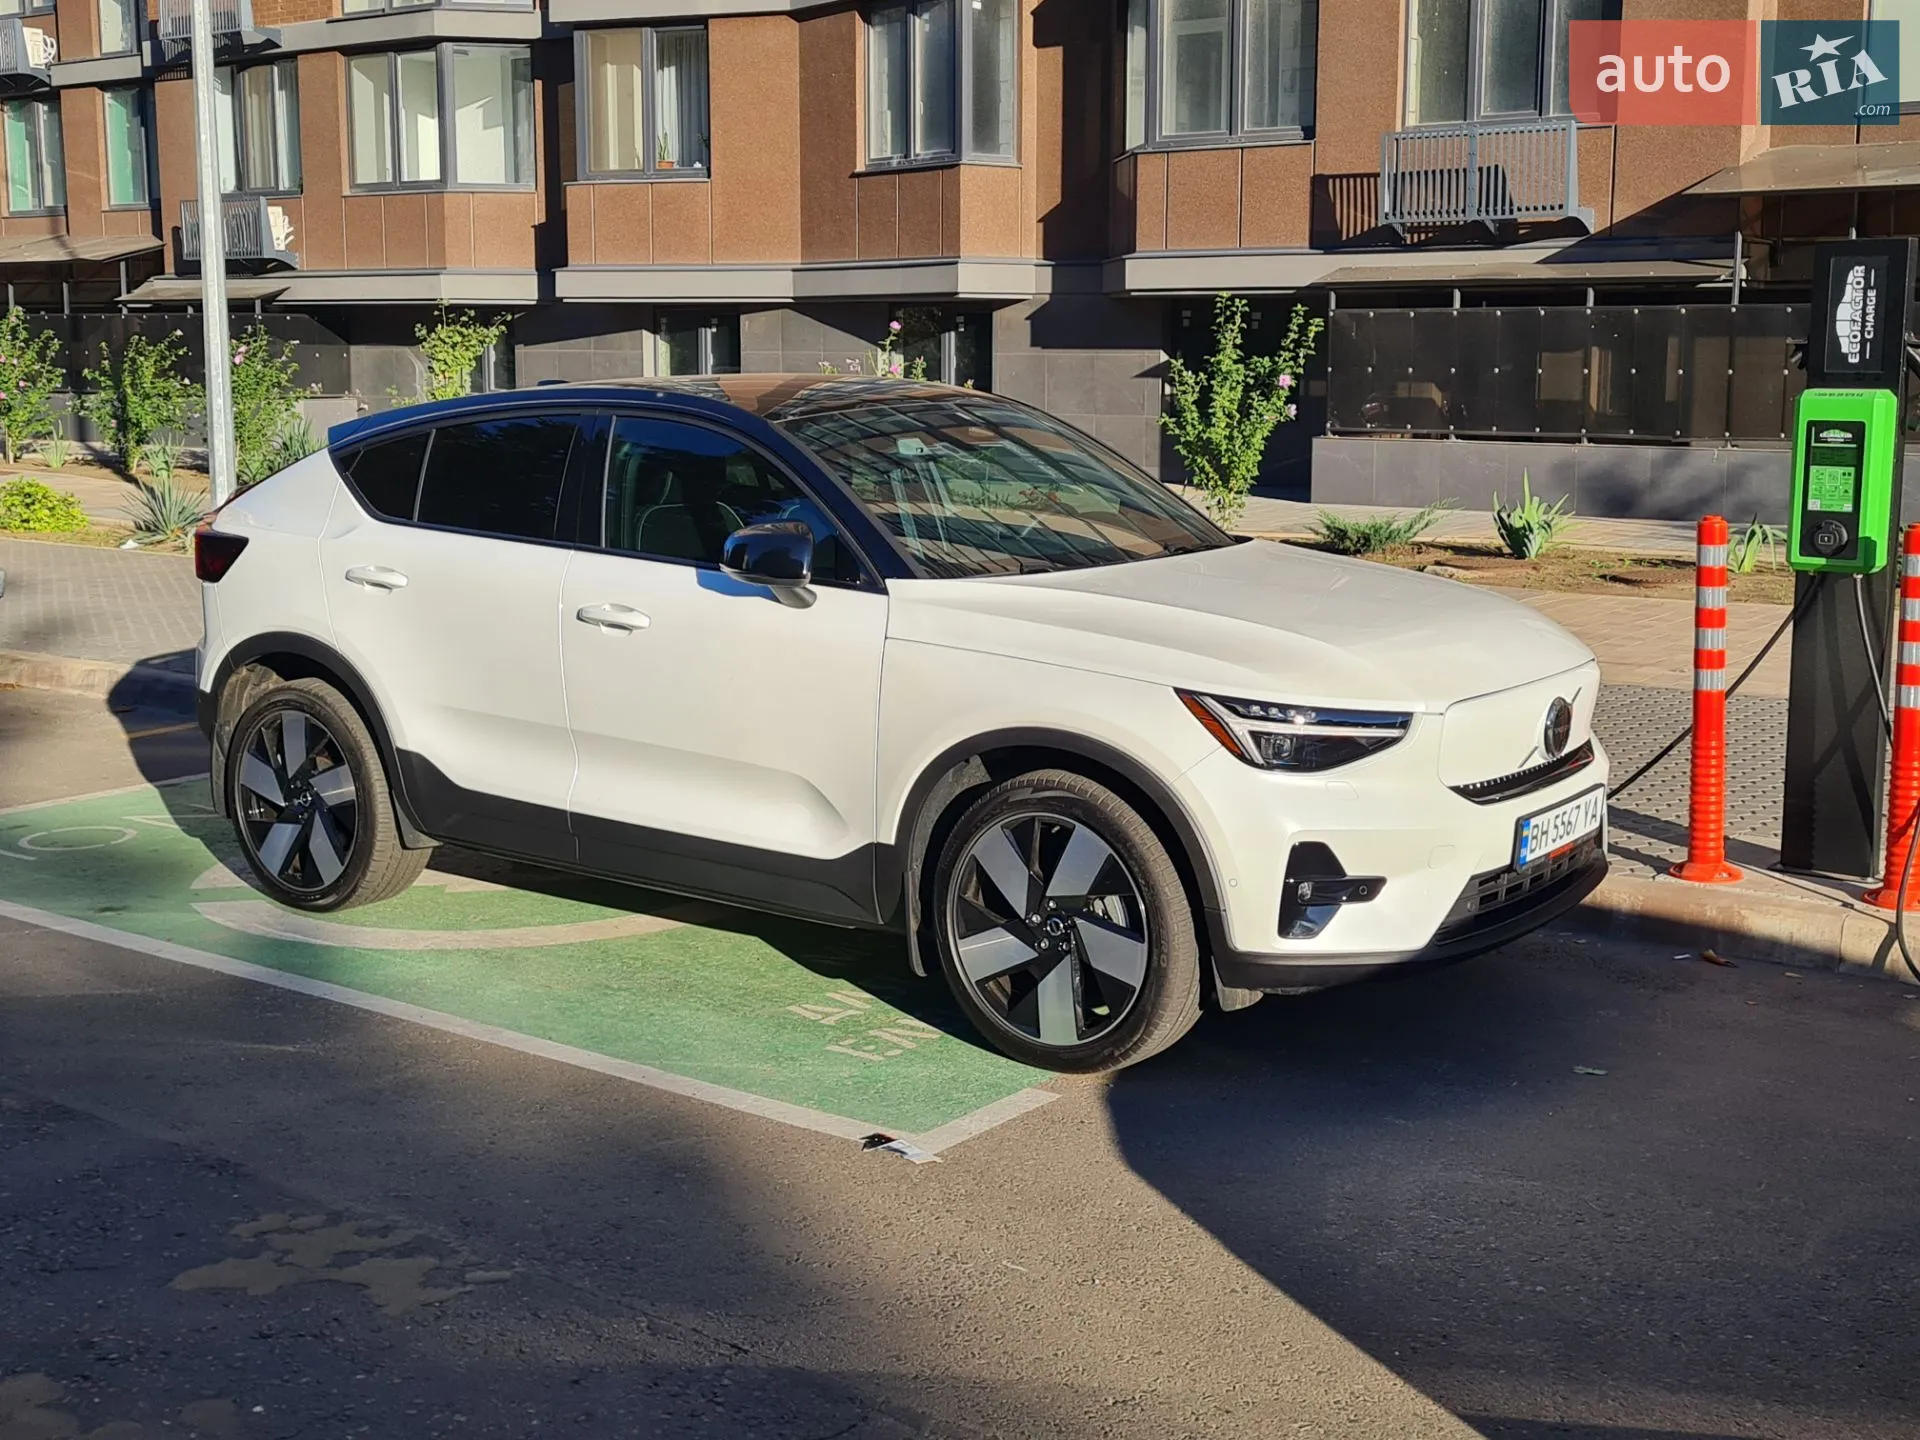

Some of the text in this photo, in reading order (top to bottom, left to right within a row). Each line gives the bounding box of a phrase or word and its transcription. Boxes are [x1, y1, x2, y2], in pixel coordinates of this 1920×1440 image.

[1848, 265, 1866, 363] ECOFACTOR
[1864, 288, 1877, 339] CHARGE
[1530, 796, 1598, 853] BH 5567 YA
